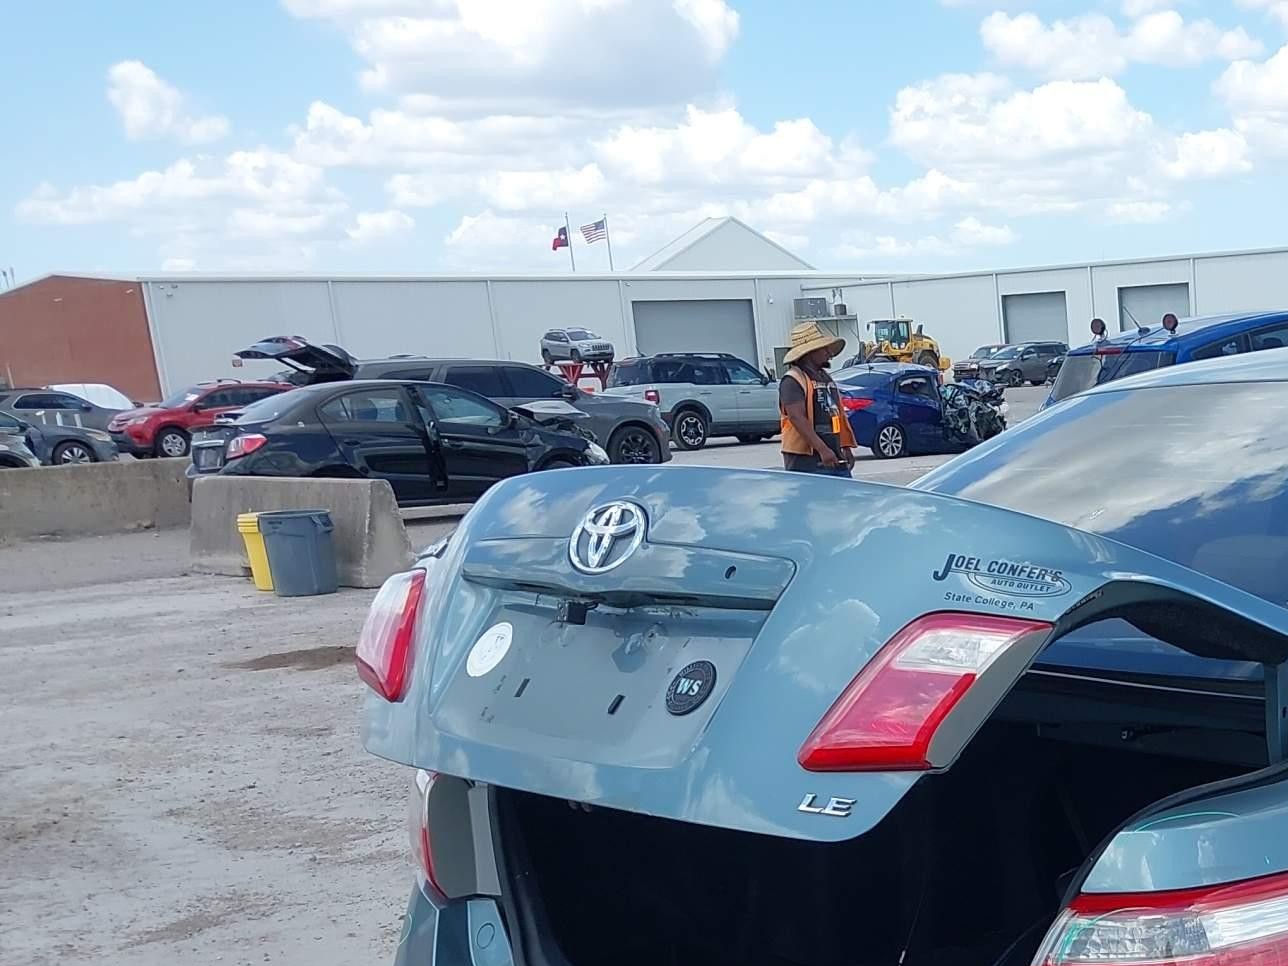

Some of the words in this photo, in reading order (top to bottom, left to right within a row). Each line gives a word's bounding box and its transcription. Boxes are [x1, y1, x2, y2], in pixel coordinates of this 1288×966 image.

[933, 554, 981, 581] JOEL
[987, 560, 1063, 582] CONFER'S
[990, 578, 1015, 588] AUTO
[1017, 582, 1051, 592] OUTLET
[944, 591, 972, 604] State
[974, 595, 1016, 609] College,
[1020, 602, 1034, 611] PA
[676, 678, 703, 695] WS
[798, 793, 857, 816] LE
